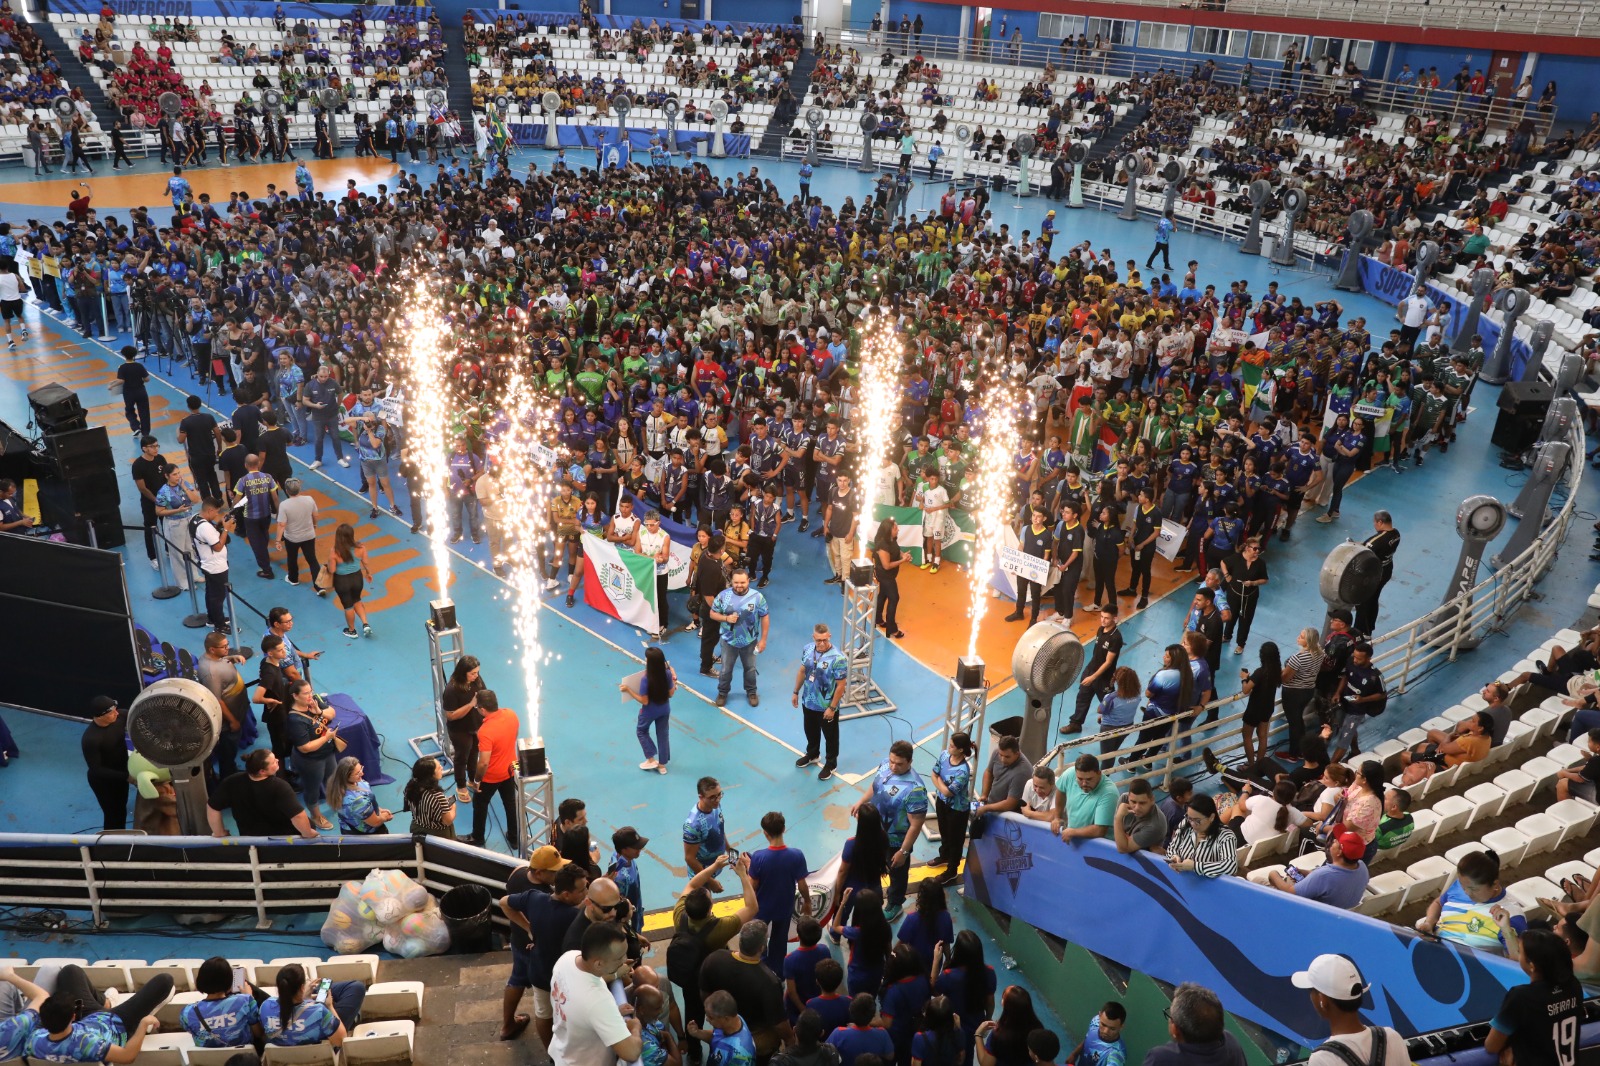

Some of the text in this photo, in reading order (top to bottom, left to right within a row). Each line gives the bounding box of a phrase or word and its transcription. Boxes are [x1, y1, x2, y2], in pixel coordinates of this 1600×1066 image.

[110, 1, 193, 17] SUPERCOPA
[1003, 547, 1020, 557] ESCOLA
[1547, 999, 1570, 1017] SAFIRA
[267, 1015, 306, 1033] JE'S
[1552, 1015, 1577, 1066] 19
